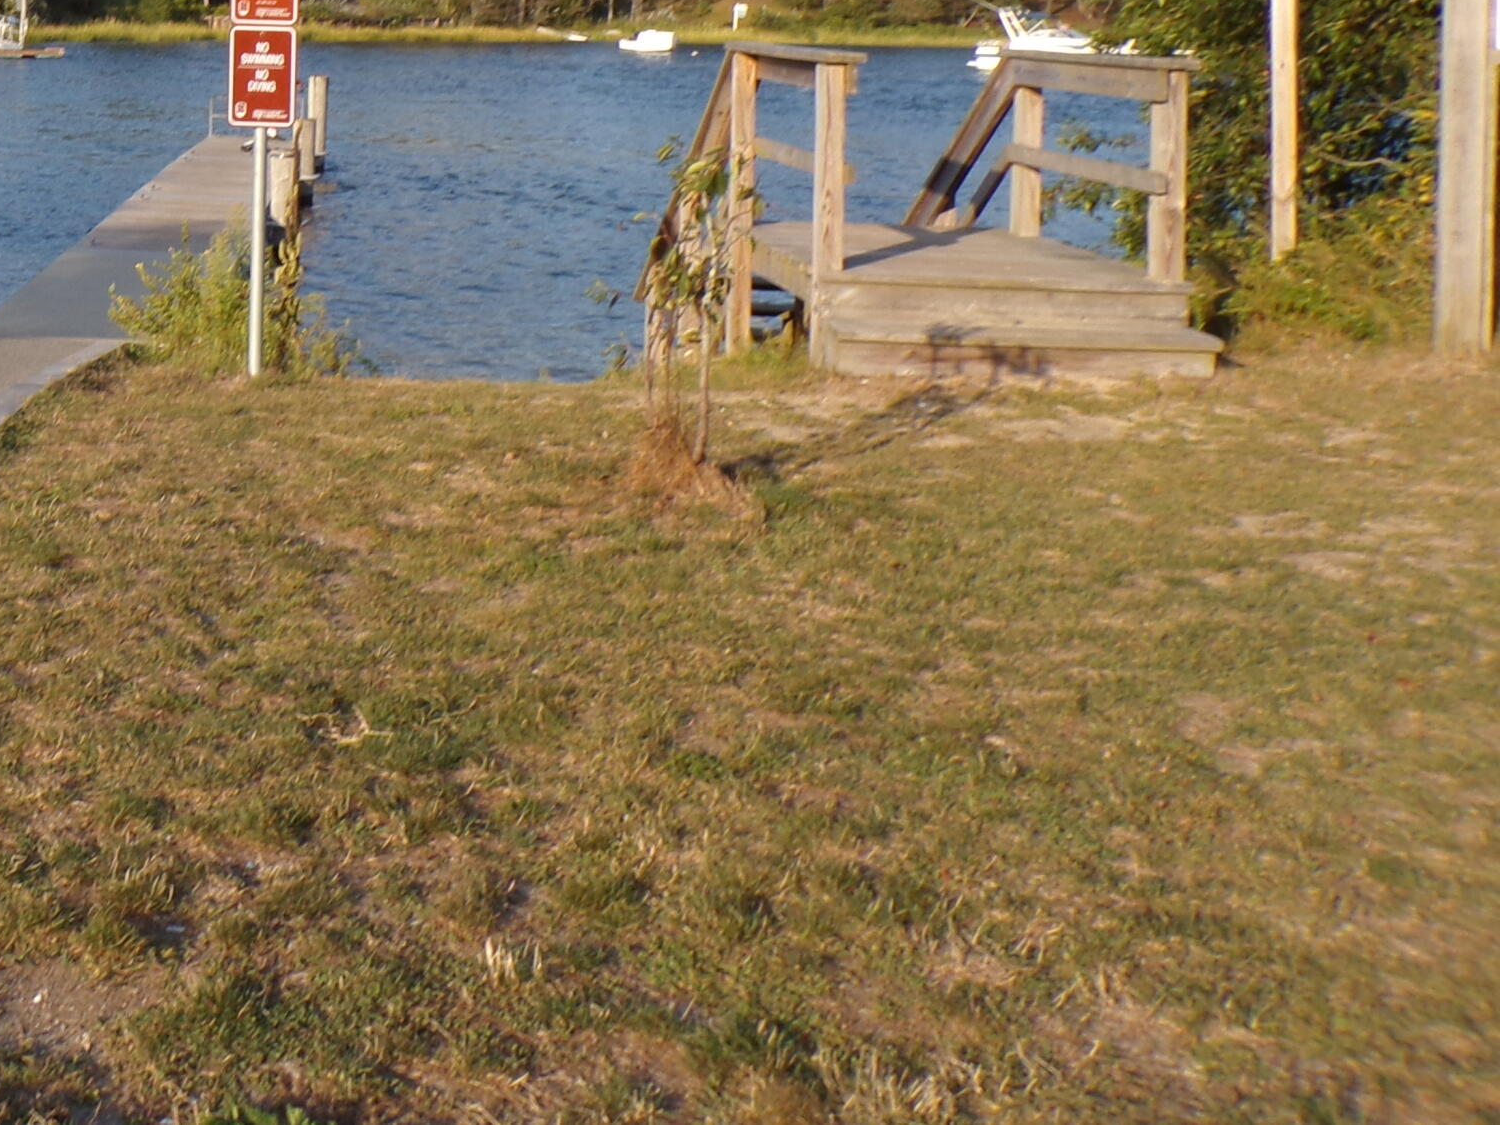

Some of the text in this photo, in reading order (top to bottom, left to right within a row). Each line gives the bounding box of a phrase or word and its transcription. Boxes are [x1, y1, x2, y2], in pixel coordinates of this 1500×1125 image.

[255, 41, 270, 53] NO
[240, 53, 285, 65] SWIMMING
[255, 69, 270, 80] NO
[247, 80, 277, 93] DIVING
